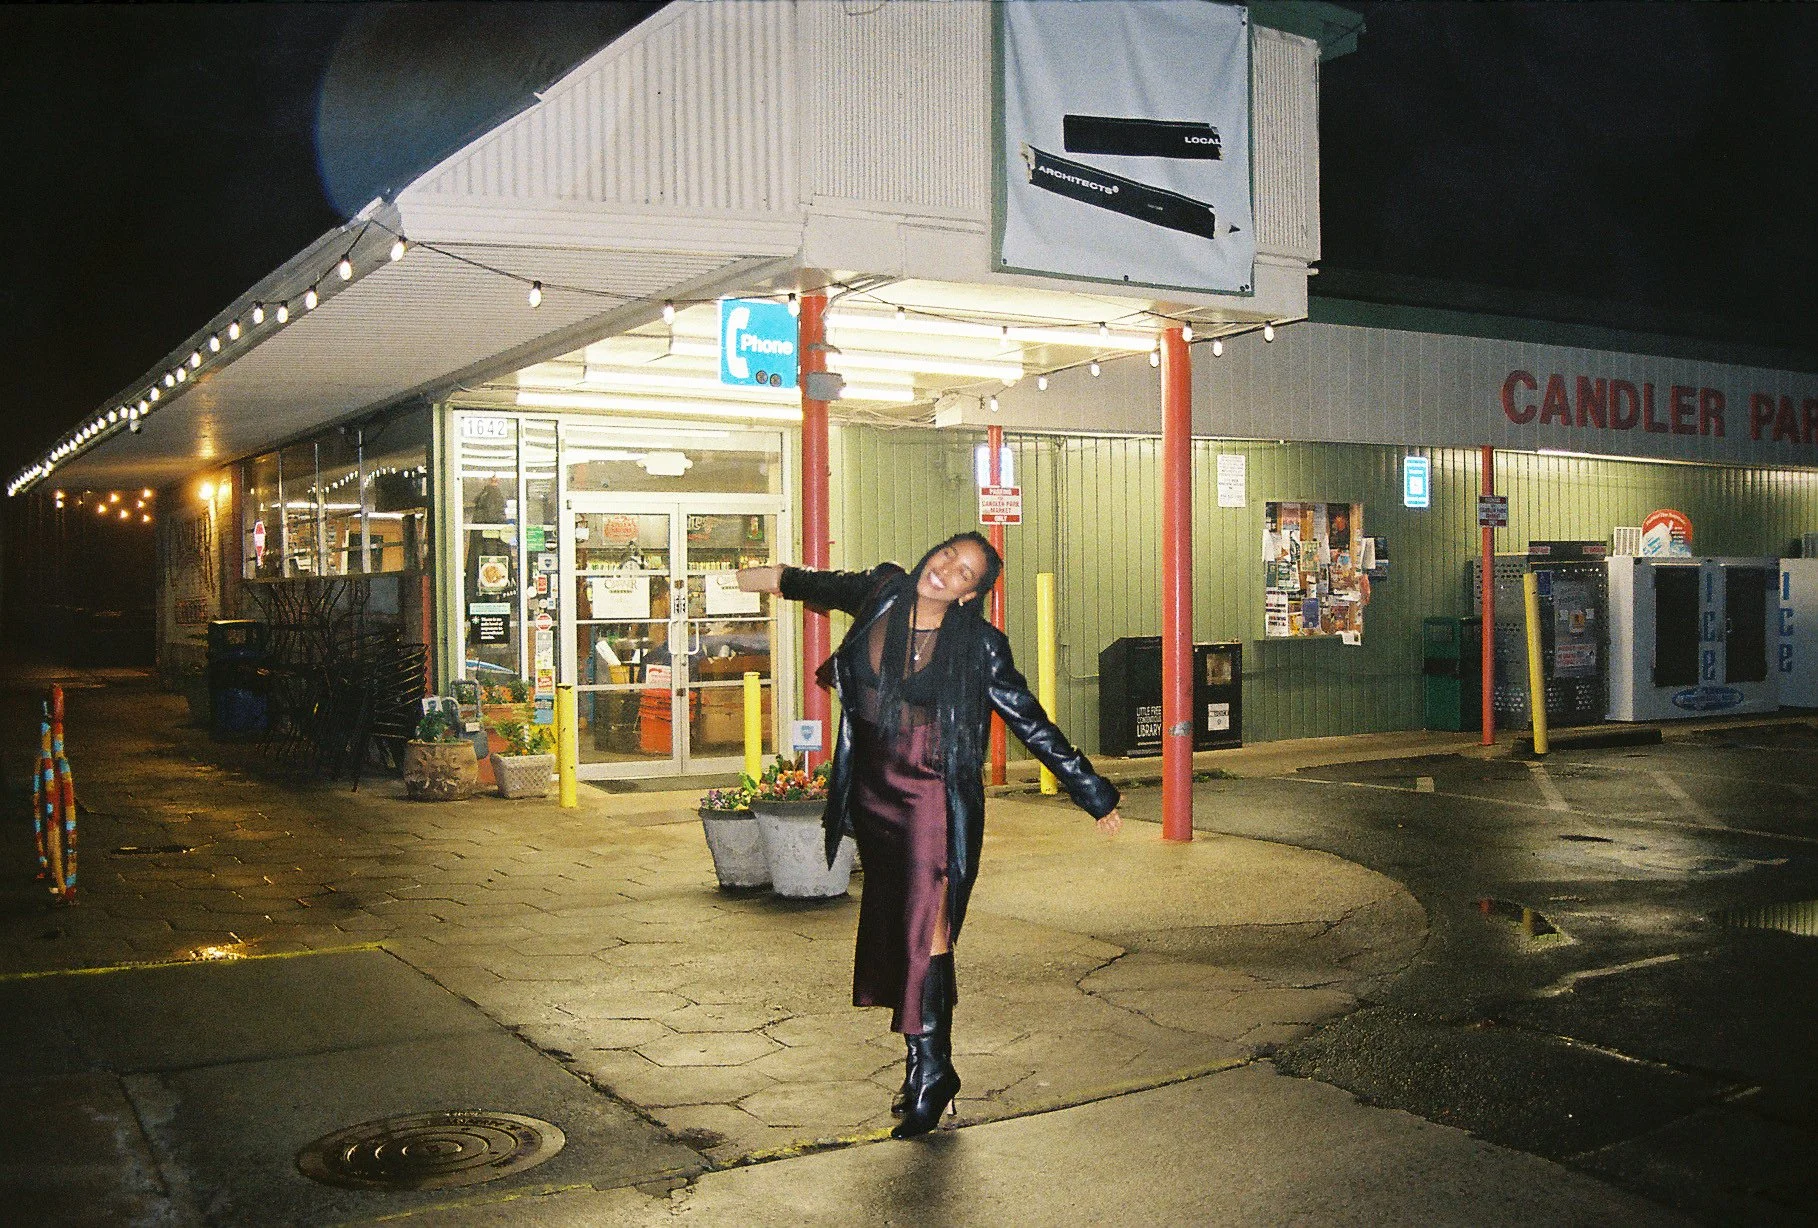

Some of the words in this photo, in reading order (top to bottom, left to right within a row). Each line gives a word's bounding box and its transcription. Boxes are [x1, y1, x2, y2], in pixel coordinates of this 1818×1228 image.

[1185, 136, 1221, 145] LOCAL
[741, 334, 793, 355] Phone
[1502, 369, 1726, 438] CANDLER
[468, 420, 505, 436] 1642
[1136, 706, 1150, 717] LITTLE
[1151, 705, 1162, 716] FREE
[1136, 723, 1162, 738] LIBRARY
